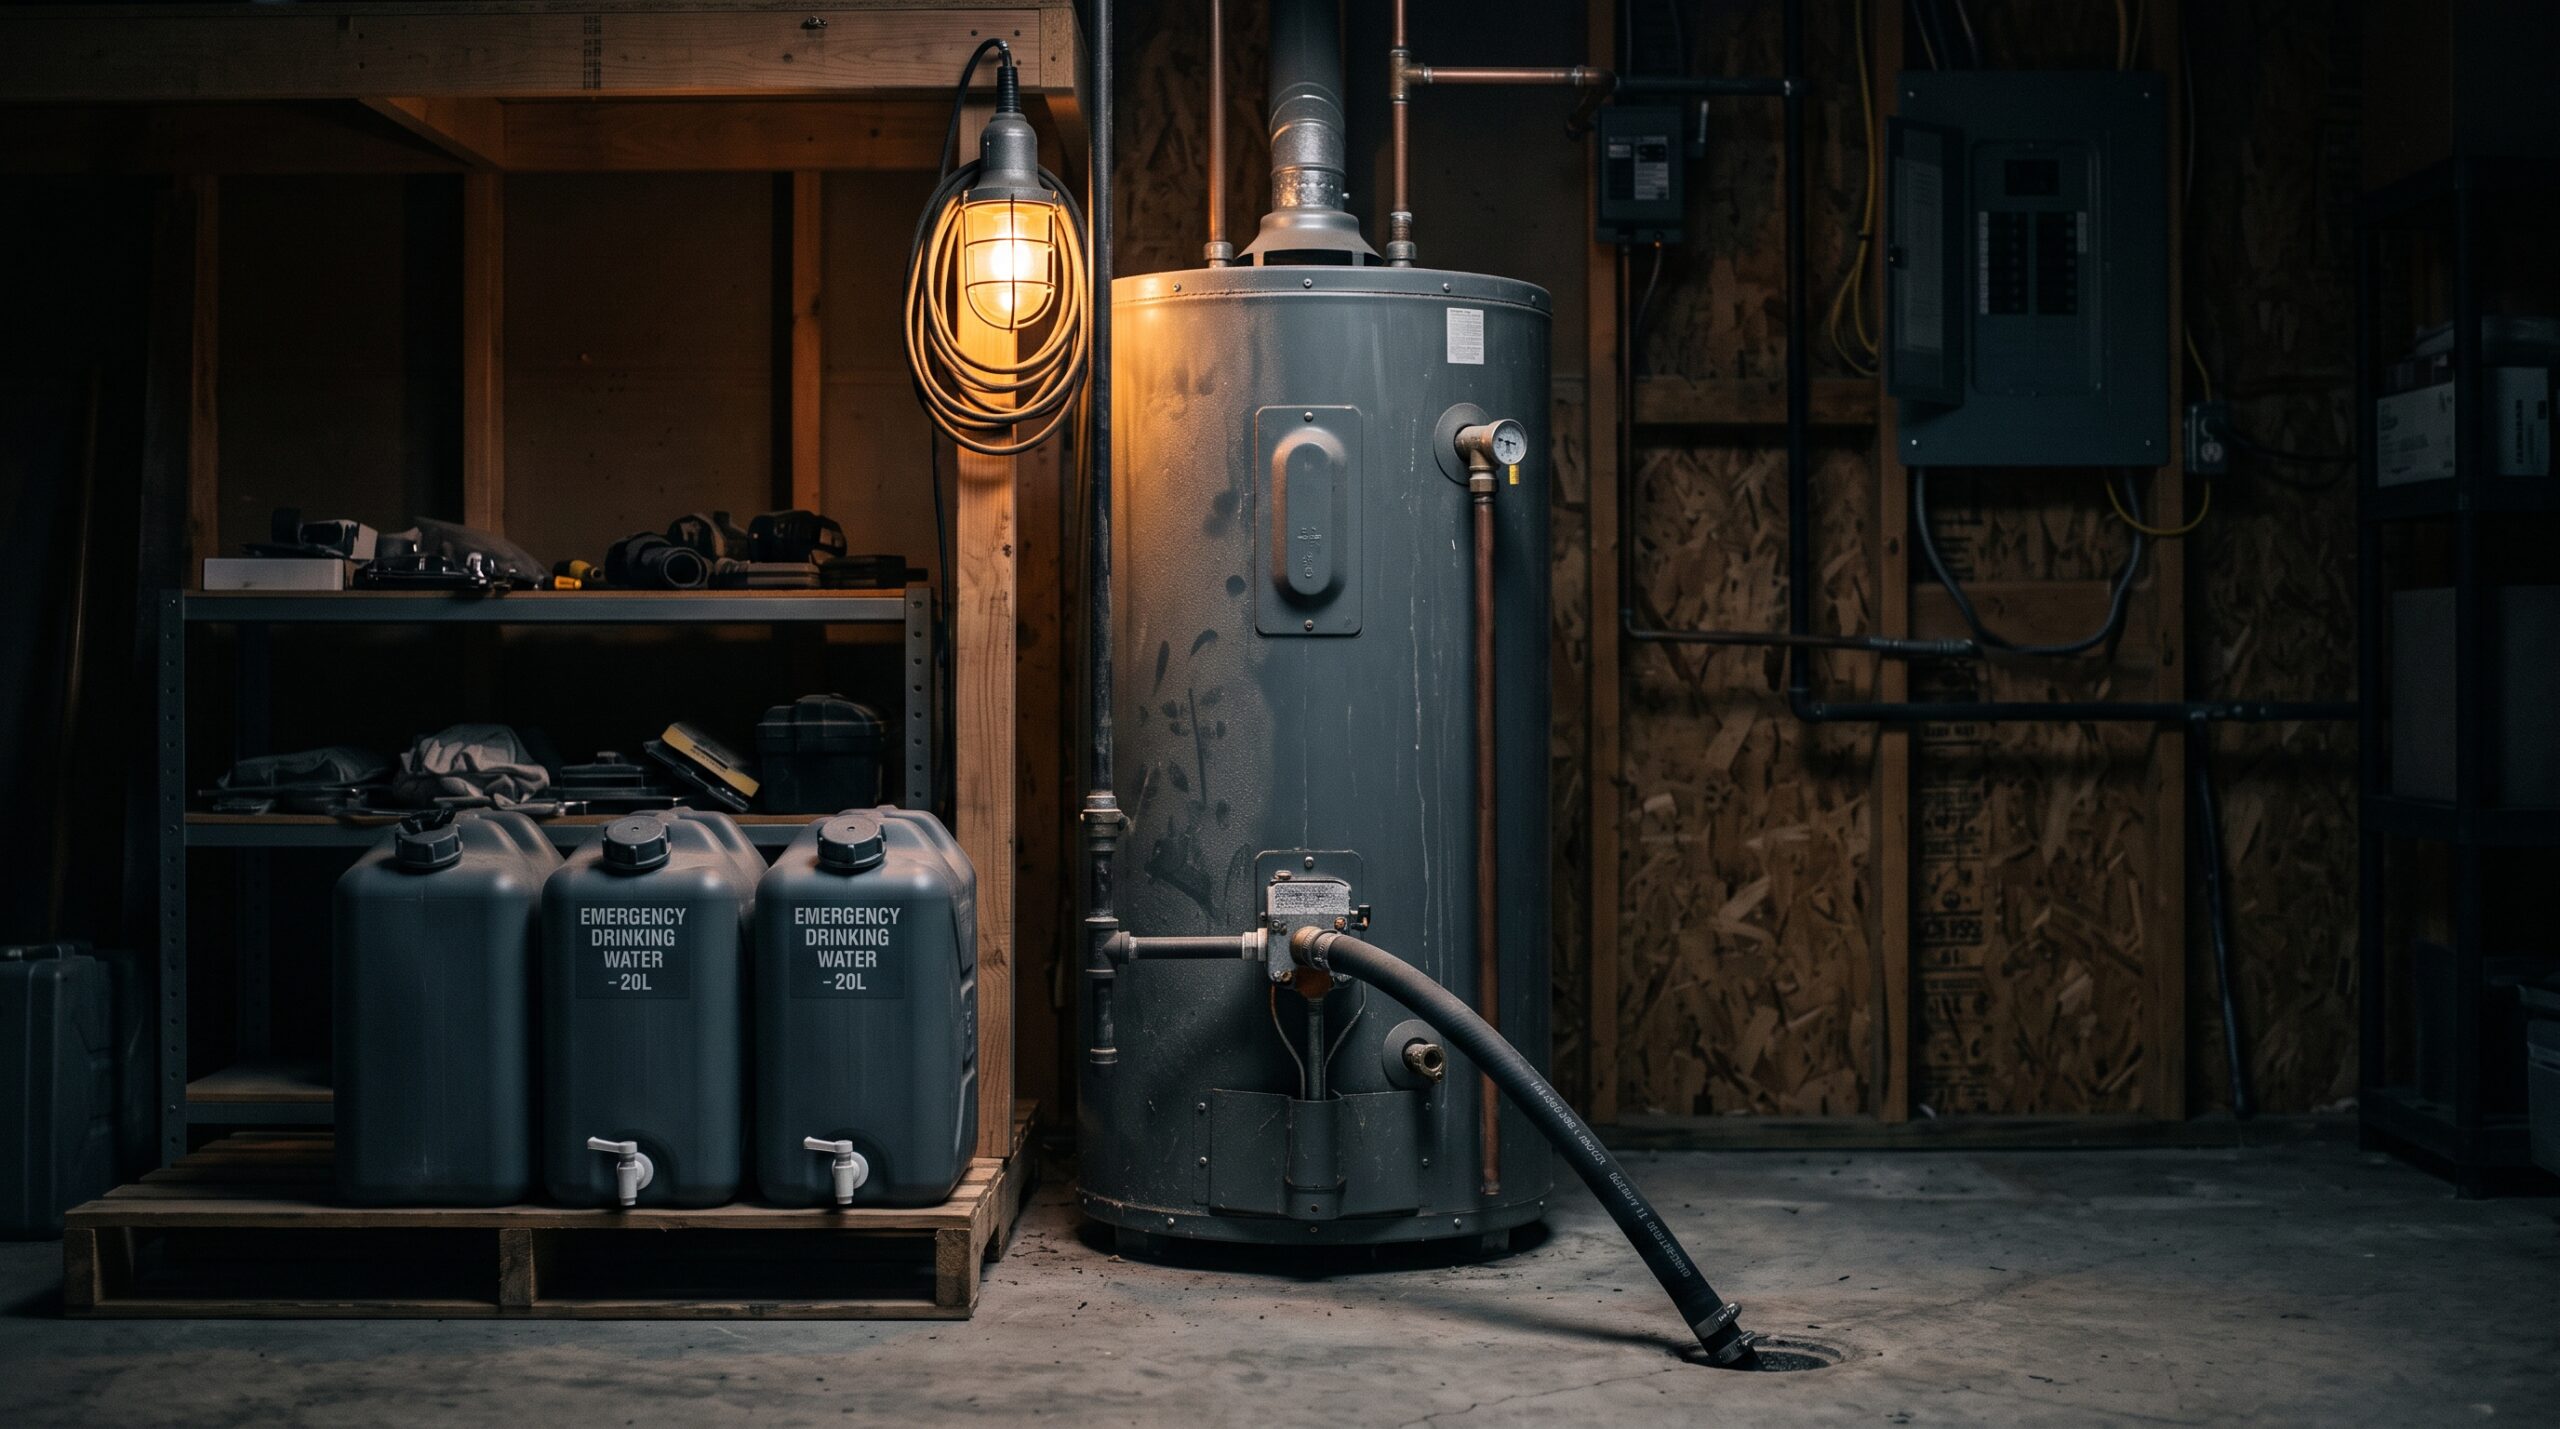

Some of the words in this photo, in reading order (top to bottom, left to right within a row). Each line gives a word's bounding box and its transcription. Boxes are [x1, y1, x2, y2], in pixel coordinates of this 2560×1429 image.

[581, 907, 687, 926] EMERGENCY
[794, 906, 901, 925] EMERGENCY
[591, 928, 675, 947] DRINKING
[805, 928, 889, 947] DRINKING
[603, 950, 663, 968] WATER
[817, 950, 877, 968] WATER
